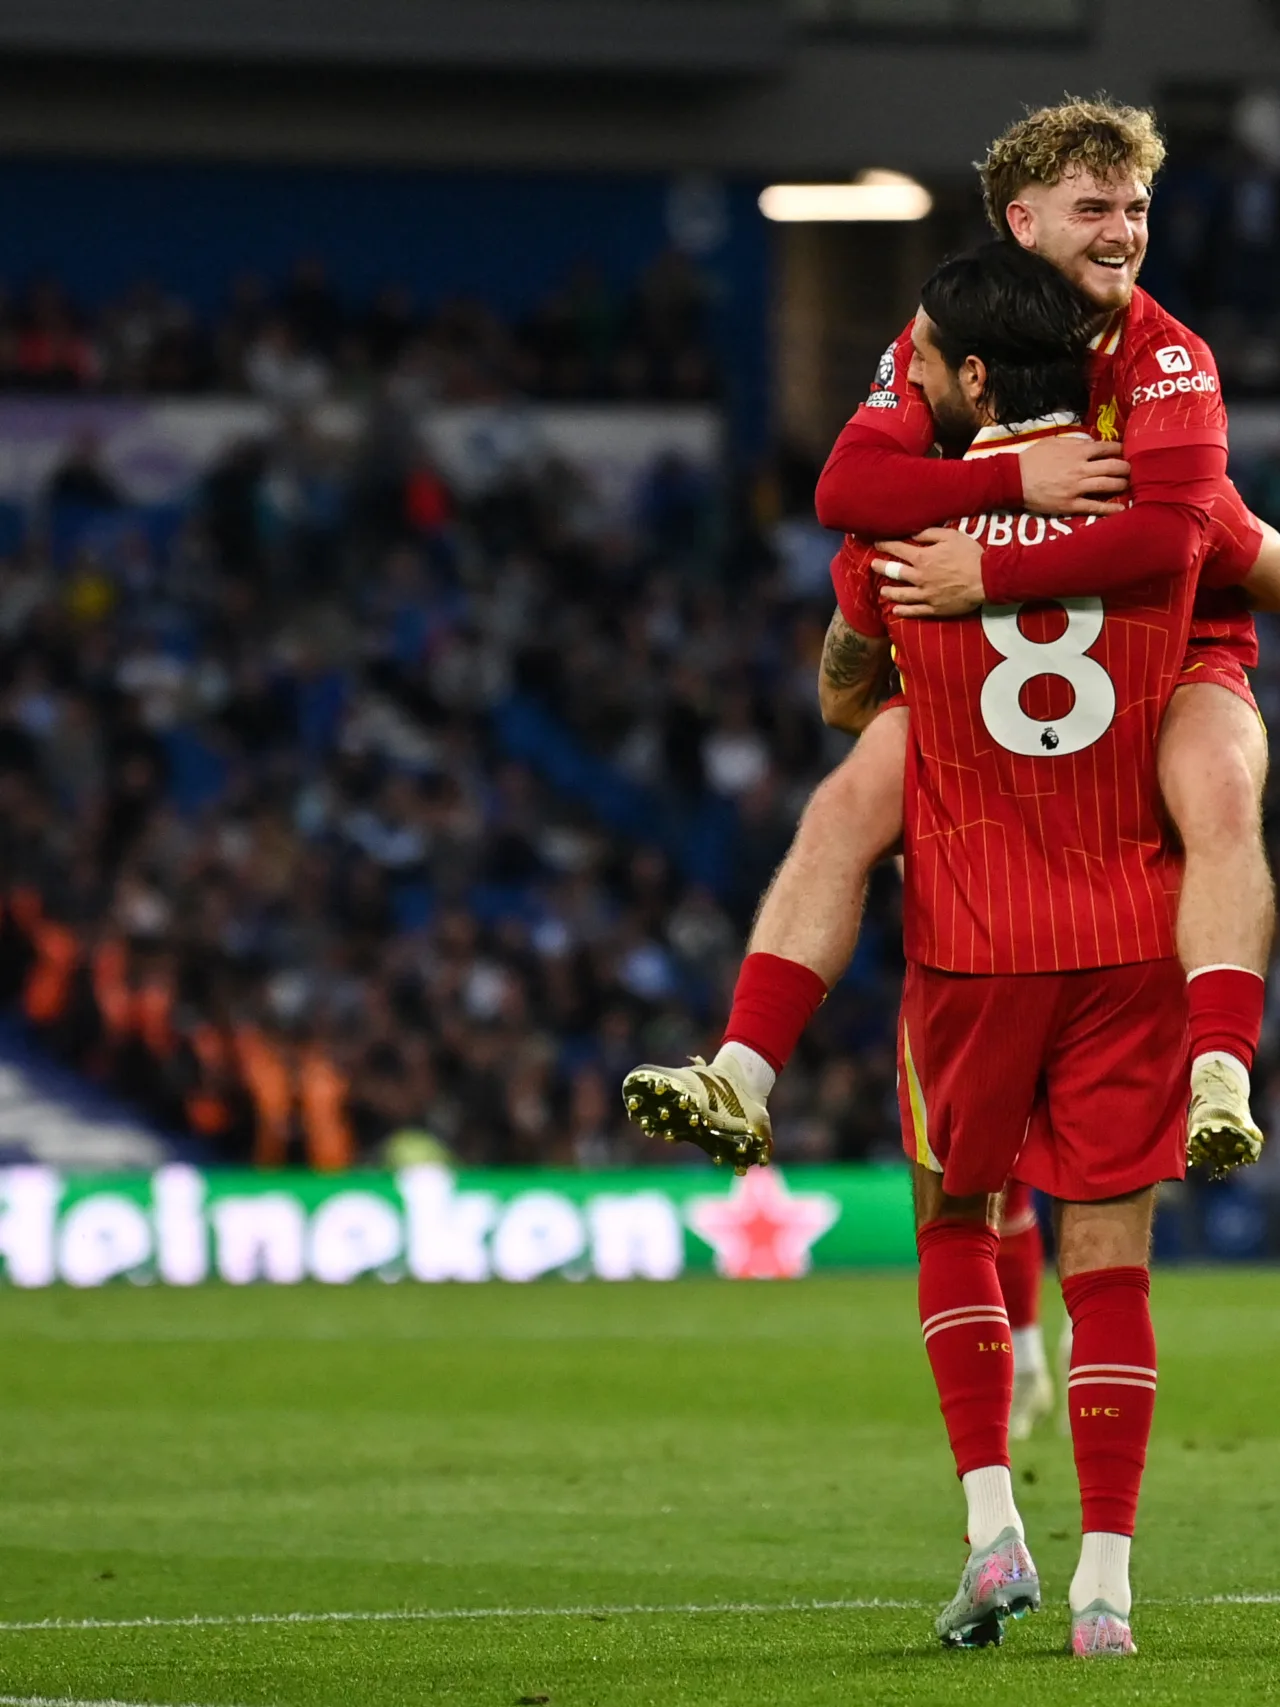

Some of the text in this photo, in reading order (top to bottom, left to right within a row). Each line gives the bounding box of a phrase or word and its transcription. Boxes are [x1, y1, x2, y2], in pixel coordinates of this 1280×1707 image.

[1132, 371, 1216, 406] Expedia
[980, 596, 1116, 757] 8
[978, 1342, 1011, 1353] LFC
[1079, 1406, 1120, 1418] LFC
